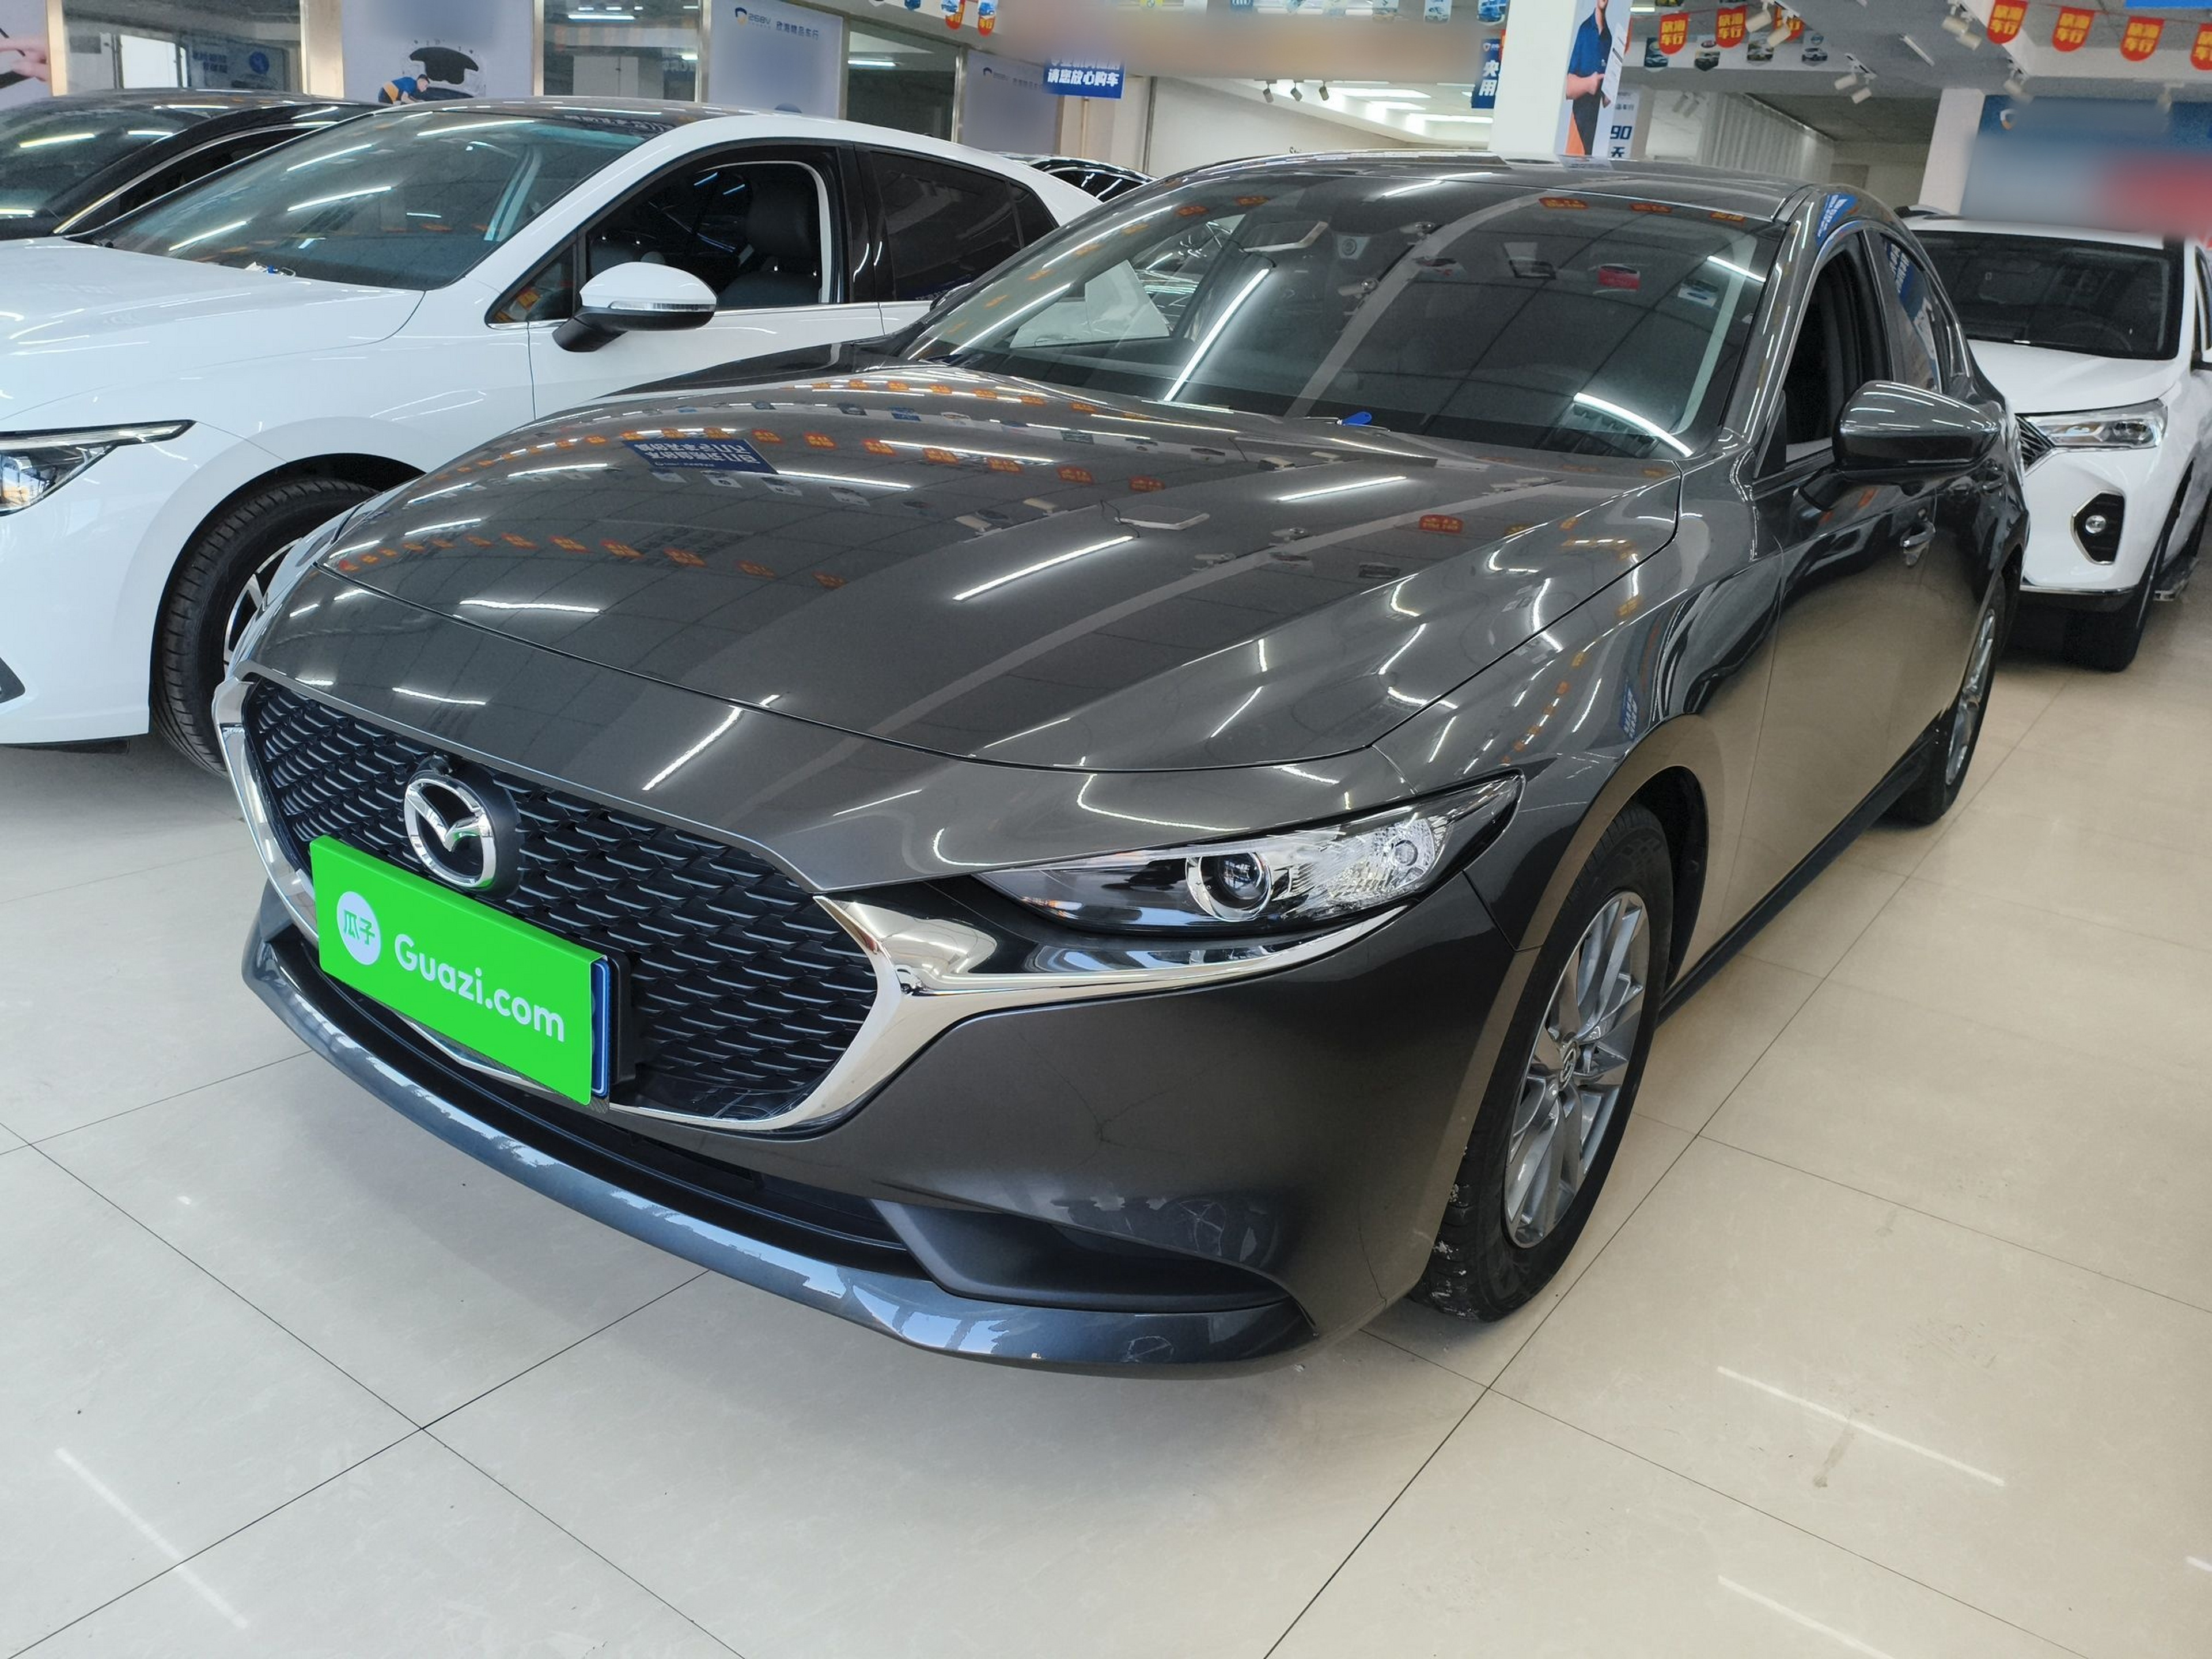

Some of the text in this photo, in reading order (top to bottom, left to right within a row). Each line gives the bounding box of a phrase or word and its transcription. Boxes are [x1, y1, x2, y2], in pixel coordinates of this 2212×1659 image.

[1047, 68, 1120, 86] 请您放心购车
[1609, 125, 1633, 140] 90
